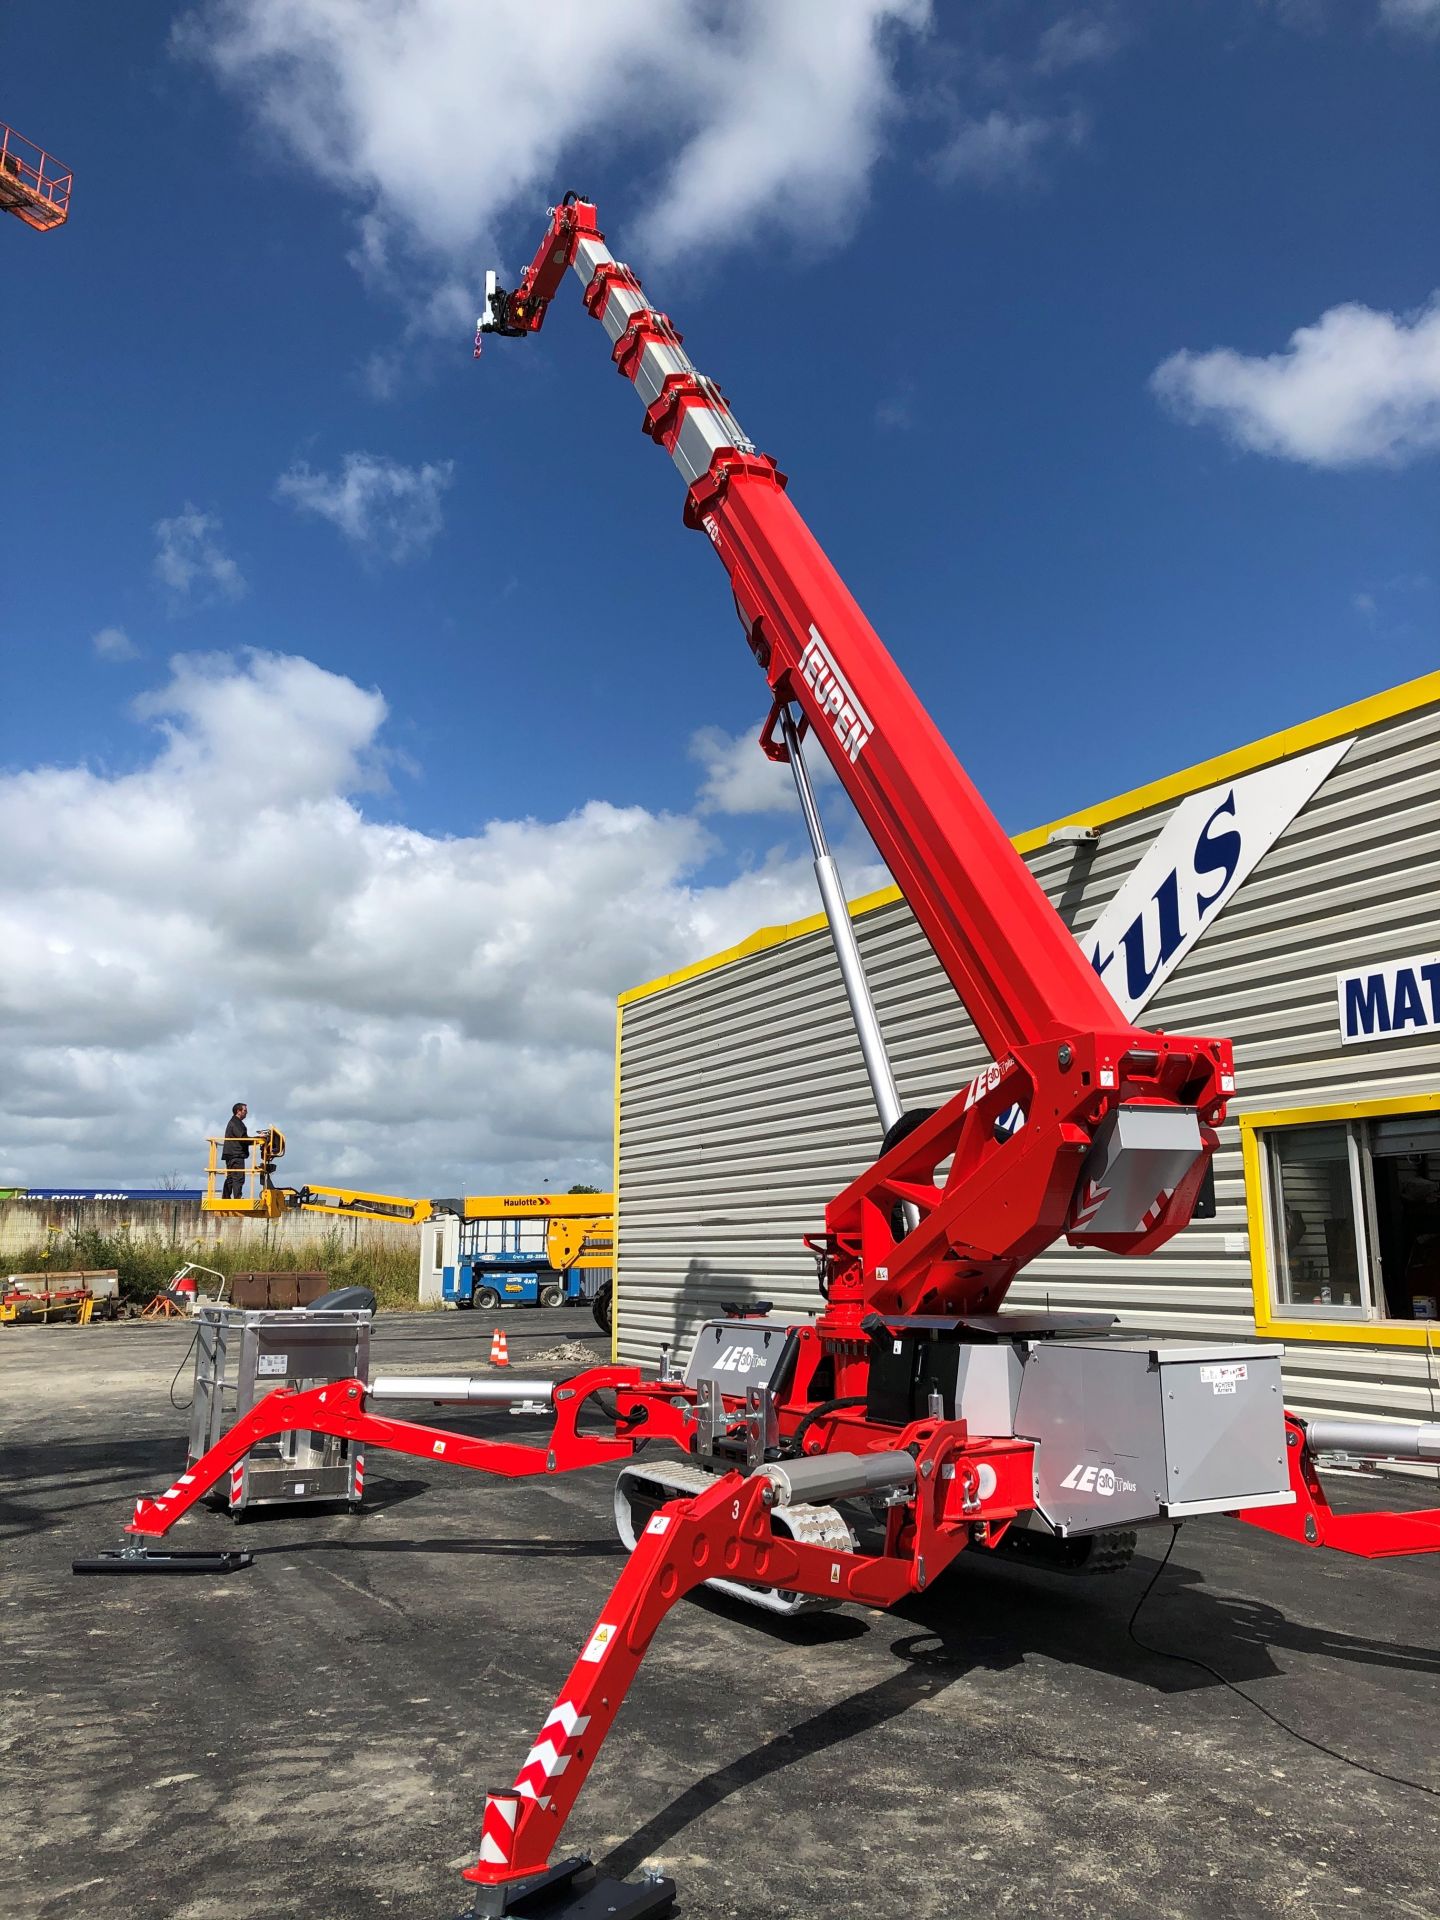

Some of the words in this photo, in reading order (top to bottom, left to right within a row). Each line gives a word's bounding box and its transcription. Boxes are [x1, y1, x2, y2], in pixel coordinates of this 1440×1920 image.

[798, 623, 874, 764] TEUPEN
[963, 1062, 1001, 1112] LEO
[503, 1198, 538, 1206] Haulotte
[713, 1345, 754, 1373] LEO
[318, 1391, 327, 1403] 4
[1060, 1464, 1115, 1497] LEO
[1122, 1480, 1137, 1492] plus
[732, 1499, 740, 1520] 3
